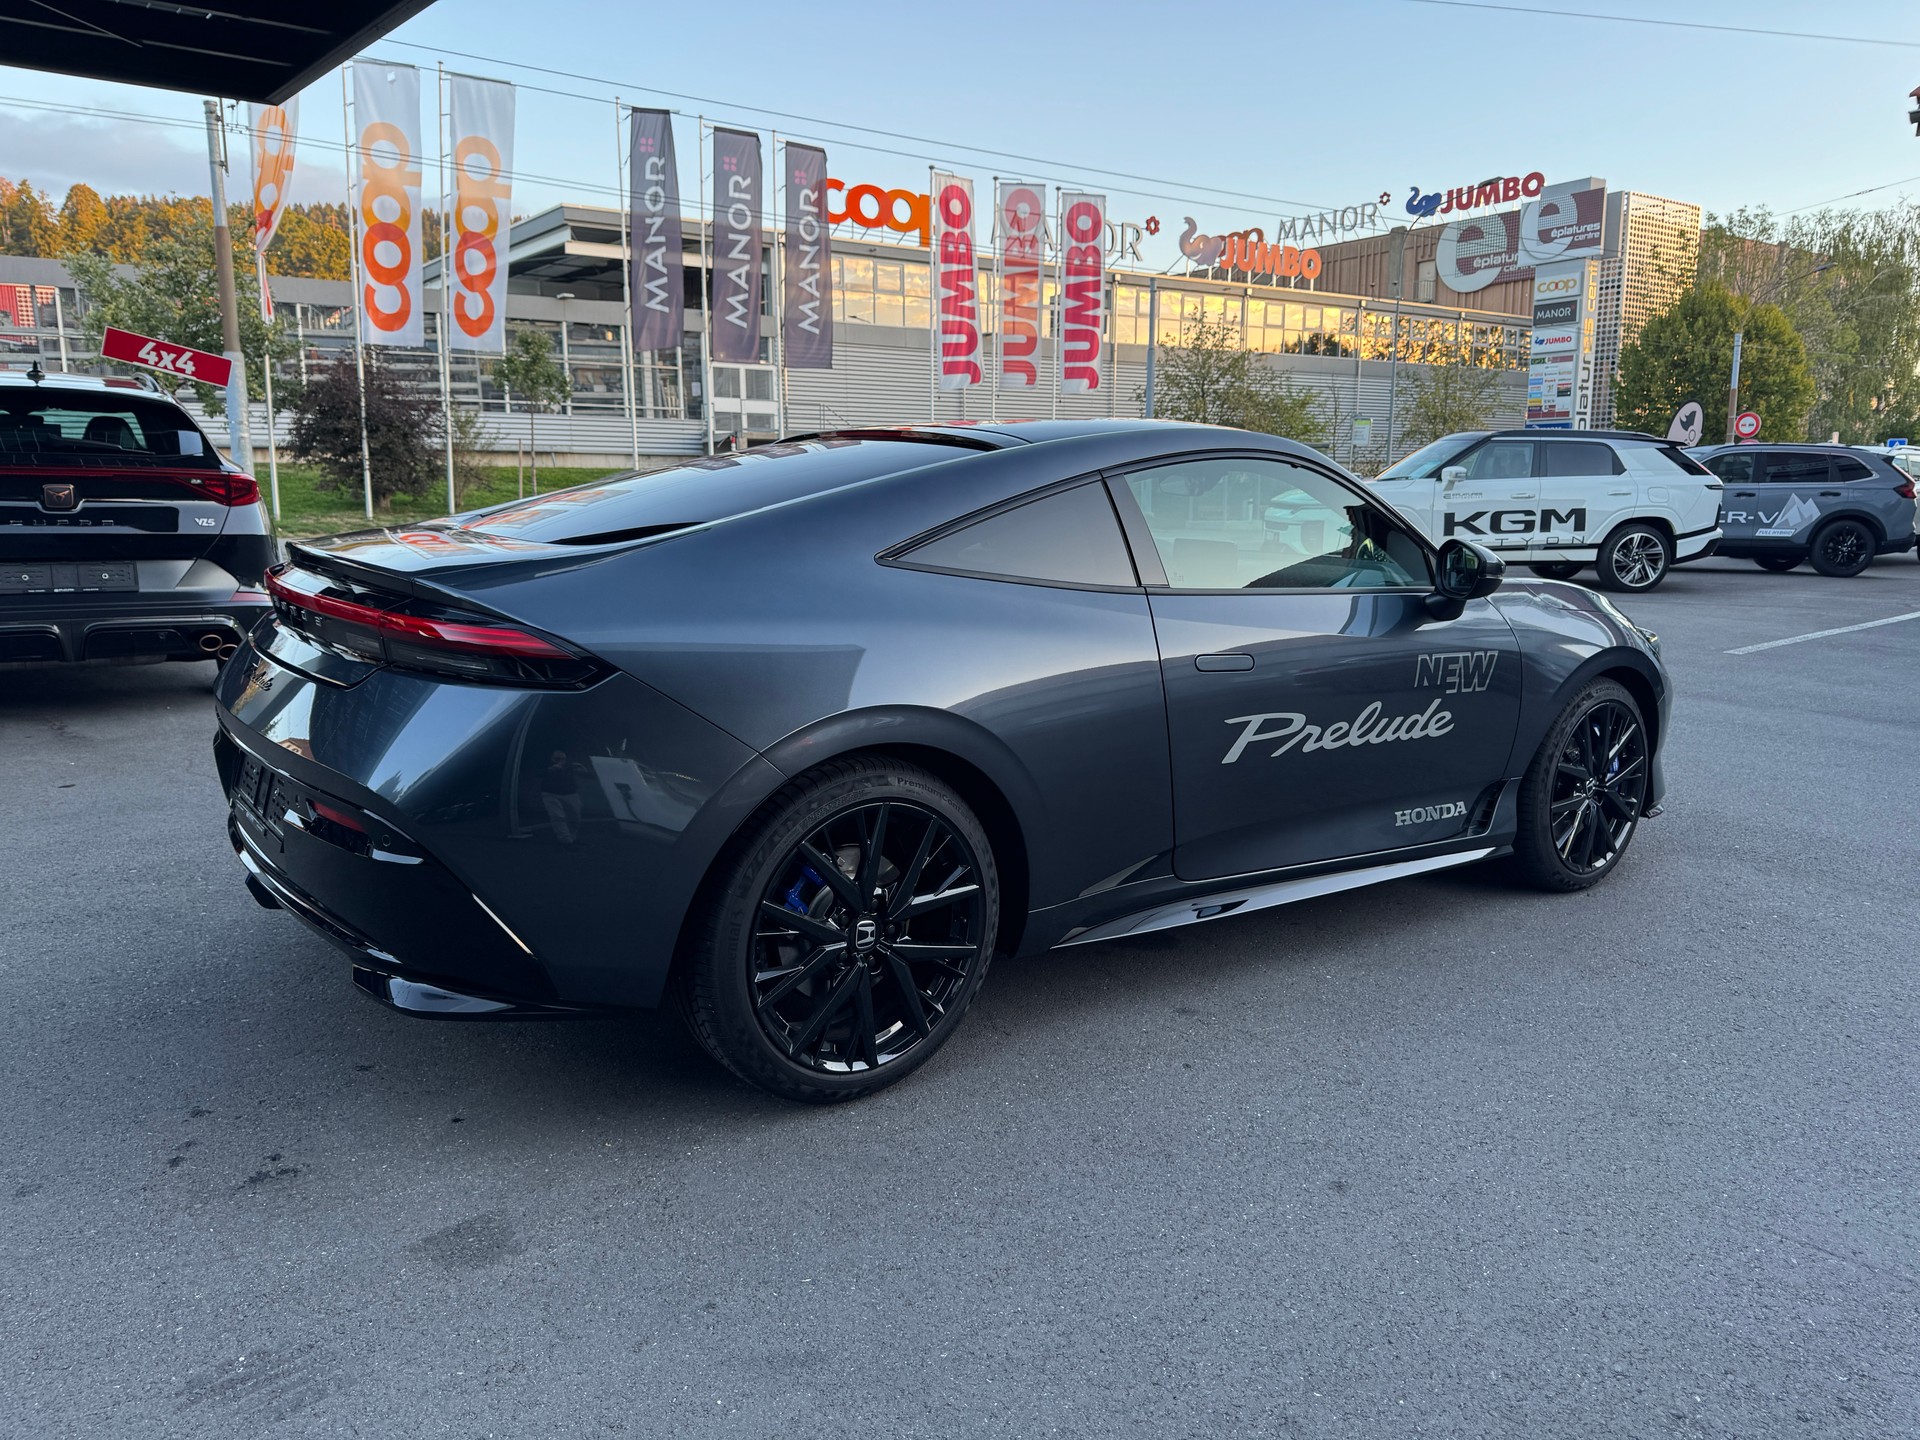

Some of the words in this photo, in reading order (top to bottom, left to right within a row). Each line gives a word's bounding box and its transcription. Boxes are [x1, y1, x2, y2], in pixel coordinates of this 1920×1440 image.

[1441, 172, 1545, 214] JUMBO
[361, 121, 421, 332] coop
[454, 135, 511, 337] coop
[644, 156, 670, 314] MANOR
[1278, 203, 1377, 243] MANOR
[1551, 222, 1600, 238] éplatures
[1574, 231, 1600, 241] centre
[725, 175, 751, 328] MANOR
[798, 188, 820, 335] MANOR
[1220, 237, 1321, 279] JUMBO
[1473, 253, 1519, 268] éplatur
[939, 184, 981, 385] JUMBO
[1003, 188, 1041, 385] JUMBO
[1063, 202, 1103, 389] JUMBO
[1537, 278, 1577, 293] coop
[1536, 307, 1571, 319] MANOR
[138, 341, 196, 375] 4x4
[1545, 336, 1572, 345] JUMBO
[194, 517, 216, 527] VZ5
[1443, 508, 1586, 536] KGM
[1414, 651, 1499, 693] NEW
[1221, 699, 1454, 764] Prelude
[1395, 801, 1467, 826] HONDA
